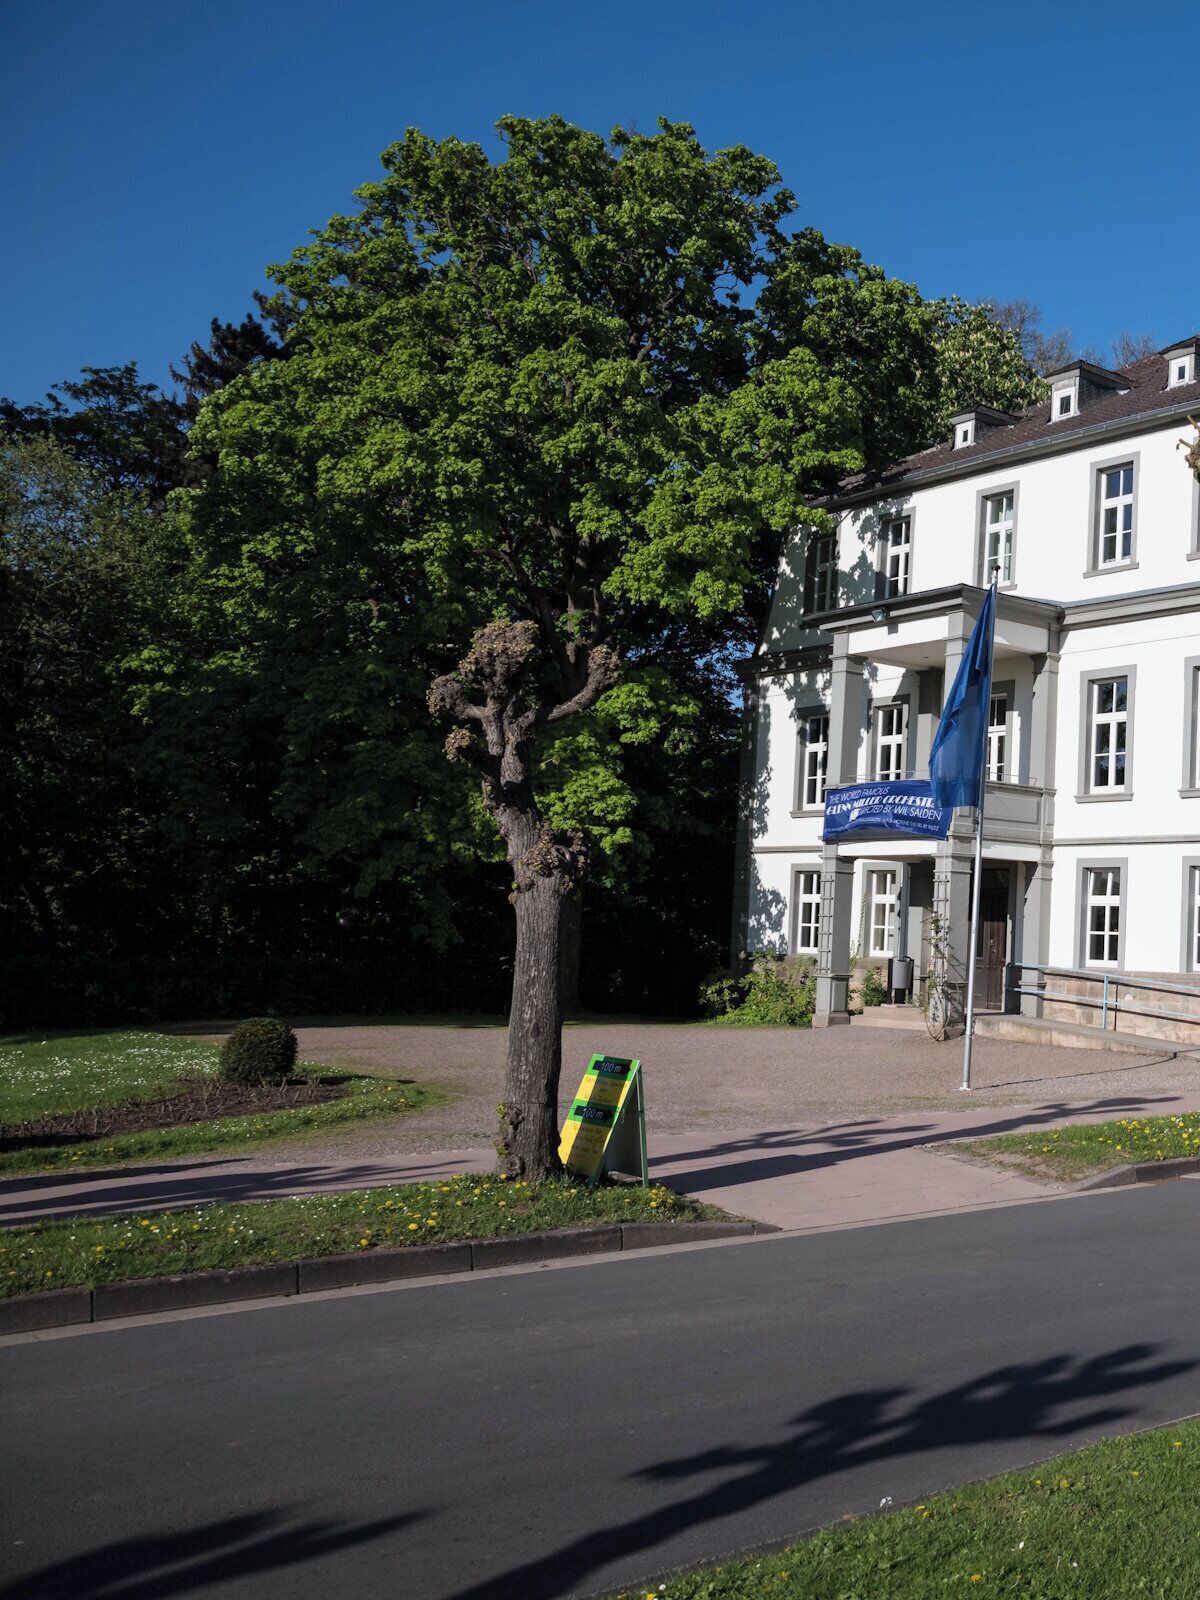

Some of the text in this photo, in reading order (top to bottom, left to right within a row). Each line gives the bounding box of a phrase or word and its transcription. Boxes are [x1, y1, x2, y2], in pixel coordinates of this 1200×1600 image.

[830, 787, 889, 804] THE WORLD FAMOUS
[826, 795, 936, 815] GLENN MILLER ORCHESTR
[883, 804, 893, 813] BY
[894, 805, 908, 815] WIL
[909, 807, 942, 820] SALDEN
[601, 1062, 614, 1072] 100
[582, 1108, 595, 1117] 100
